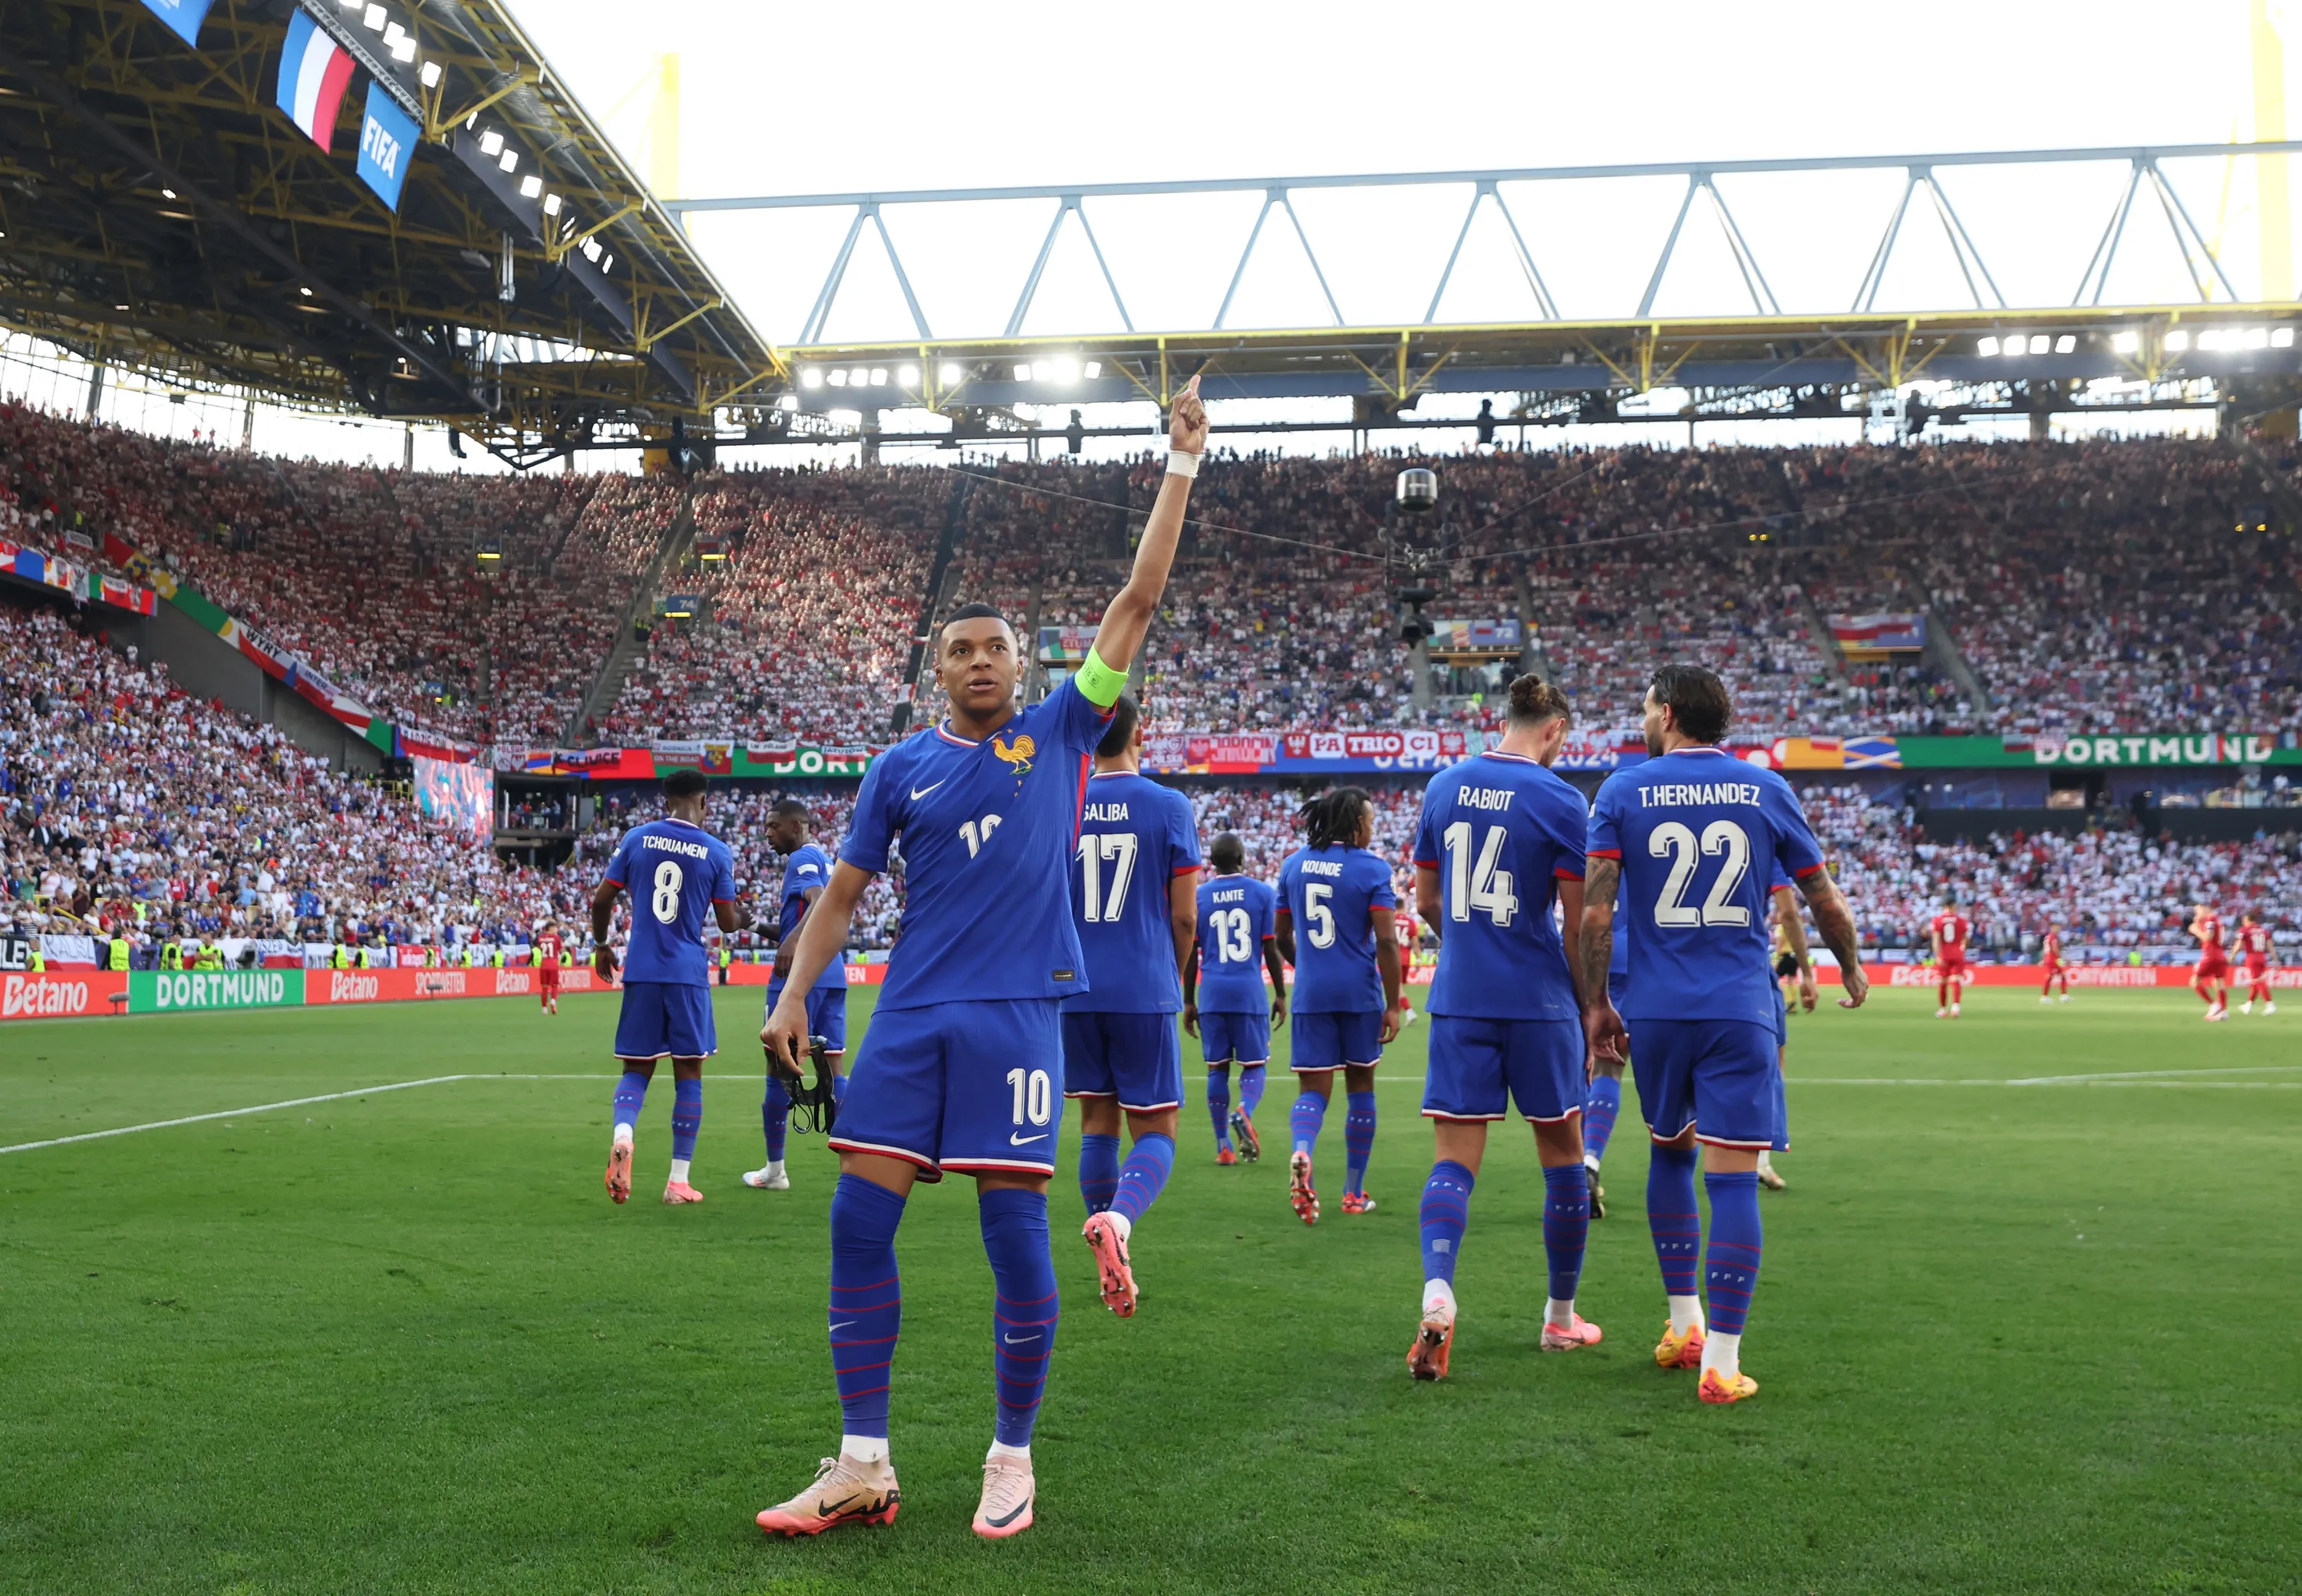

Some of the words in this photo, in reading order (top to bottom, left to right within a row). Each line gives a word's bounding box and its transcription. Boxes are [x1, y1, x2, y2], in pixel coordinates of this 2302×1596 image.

[363, 115, 401, 180] FIFA
[246, 628, 282, 658] WYRY
[1496, 627, 1513, 638] 72
[305, 670, 328, 689] INTER
[1314, 737, 1341, 752] PA
[1348, 736, 1401, 753] TRIO
[1410, 737, 1434, 750] CI
[2035, 737, 2273, 764] DORTMUND
[1458, 785, 1515, 812] RABIOT
[1638, 783, 1761, 808] T.HERNANDEZ
[1083, 803, 1129, 822] SALIBA
[642, 835, 708, 860] TCHOUAMENI
[1076, 833, 1137, 922] 17
[1301, 859, 1343, 877] KOUNDE
[1443, 821, 1519, 927] 14
[1648, 819, 1750, 928] 22
[652, 860, 683, 925] 8
[1212, 889, 1245, 903] KANTE
[1305, 882, 1336, 949] 5
[1209, 908, 1252, 964] 13
[540, 942, 553, 958] 21
[157, 972, 284, 1007] DORTMUND
[331, 970, 378, 1001] Betano
[415, 971, 466, 996] SPORTWETTEN
[496, 969, 530, 994] Betano
[1890, 965, 1975, 987] Betao
[2, 974, 88, 1017] Betano
[1007, 1067, 1050, 1126] 10
